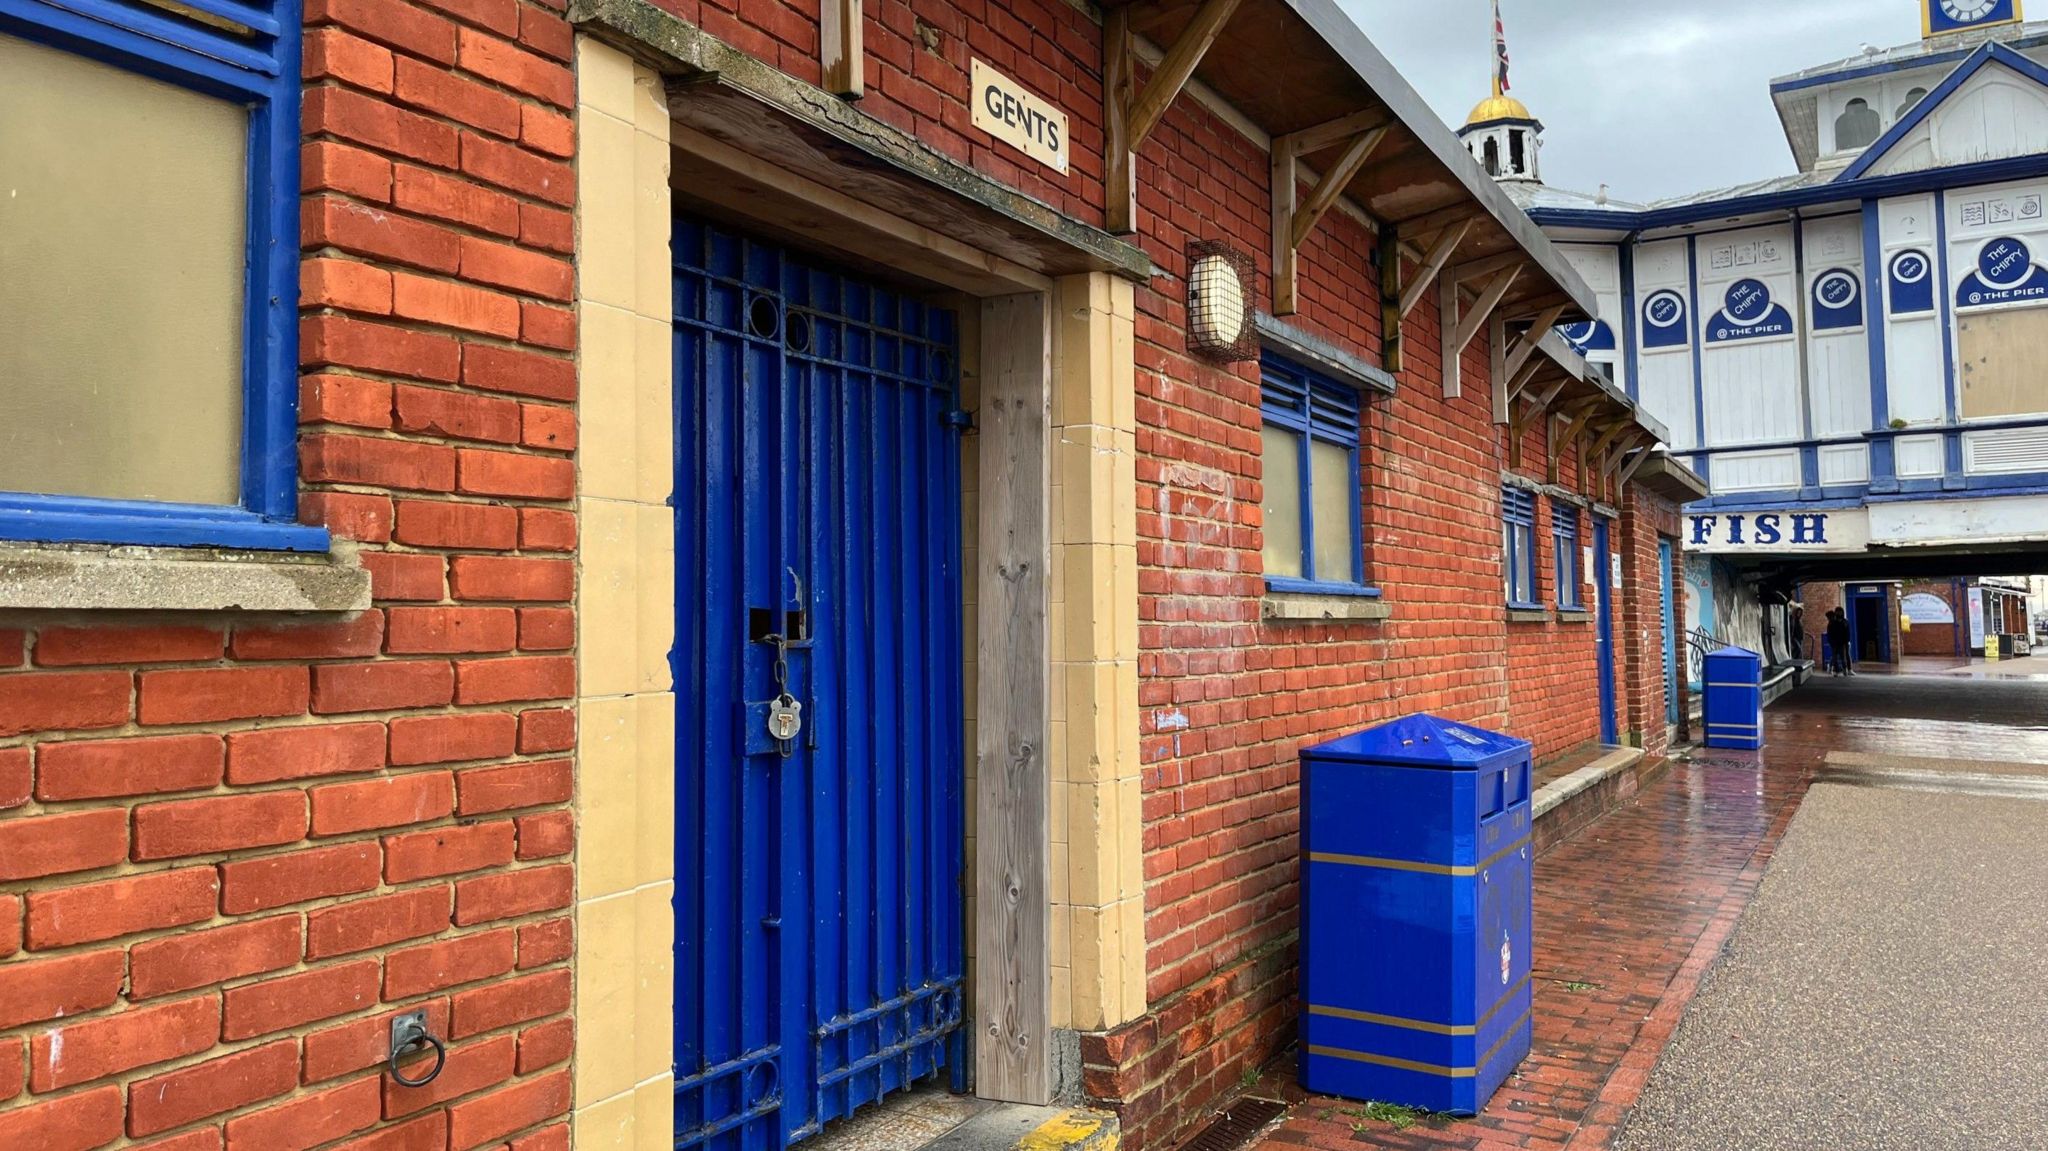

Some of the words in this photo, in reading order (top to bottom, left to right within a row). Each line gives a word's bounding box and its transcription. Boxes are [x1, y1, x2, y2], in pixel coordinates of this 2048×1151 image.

[984, 85, 1059, 152] GENTS
[1987, 243, 2008, 261] THE
[1990, 248, 2024, 277] CHIPPY
[1731, 284, 1750, 302] THE
[1734, 288, 1763, 316] CHIPPY
[1969, 291, 1982, 304] @
[1983, 290, 2010, 300] THE
[2013, 286, 2045, 297] PIER
[1716, 327, 1728, 340] @
[1729, 327, 1752, 337] THE
[1755, 324, 1782, 334] PIER
[1688, 512, 1829, 546] FISH
